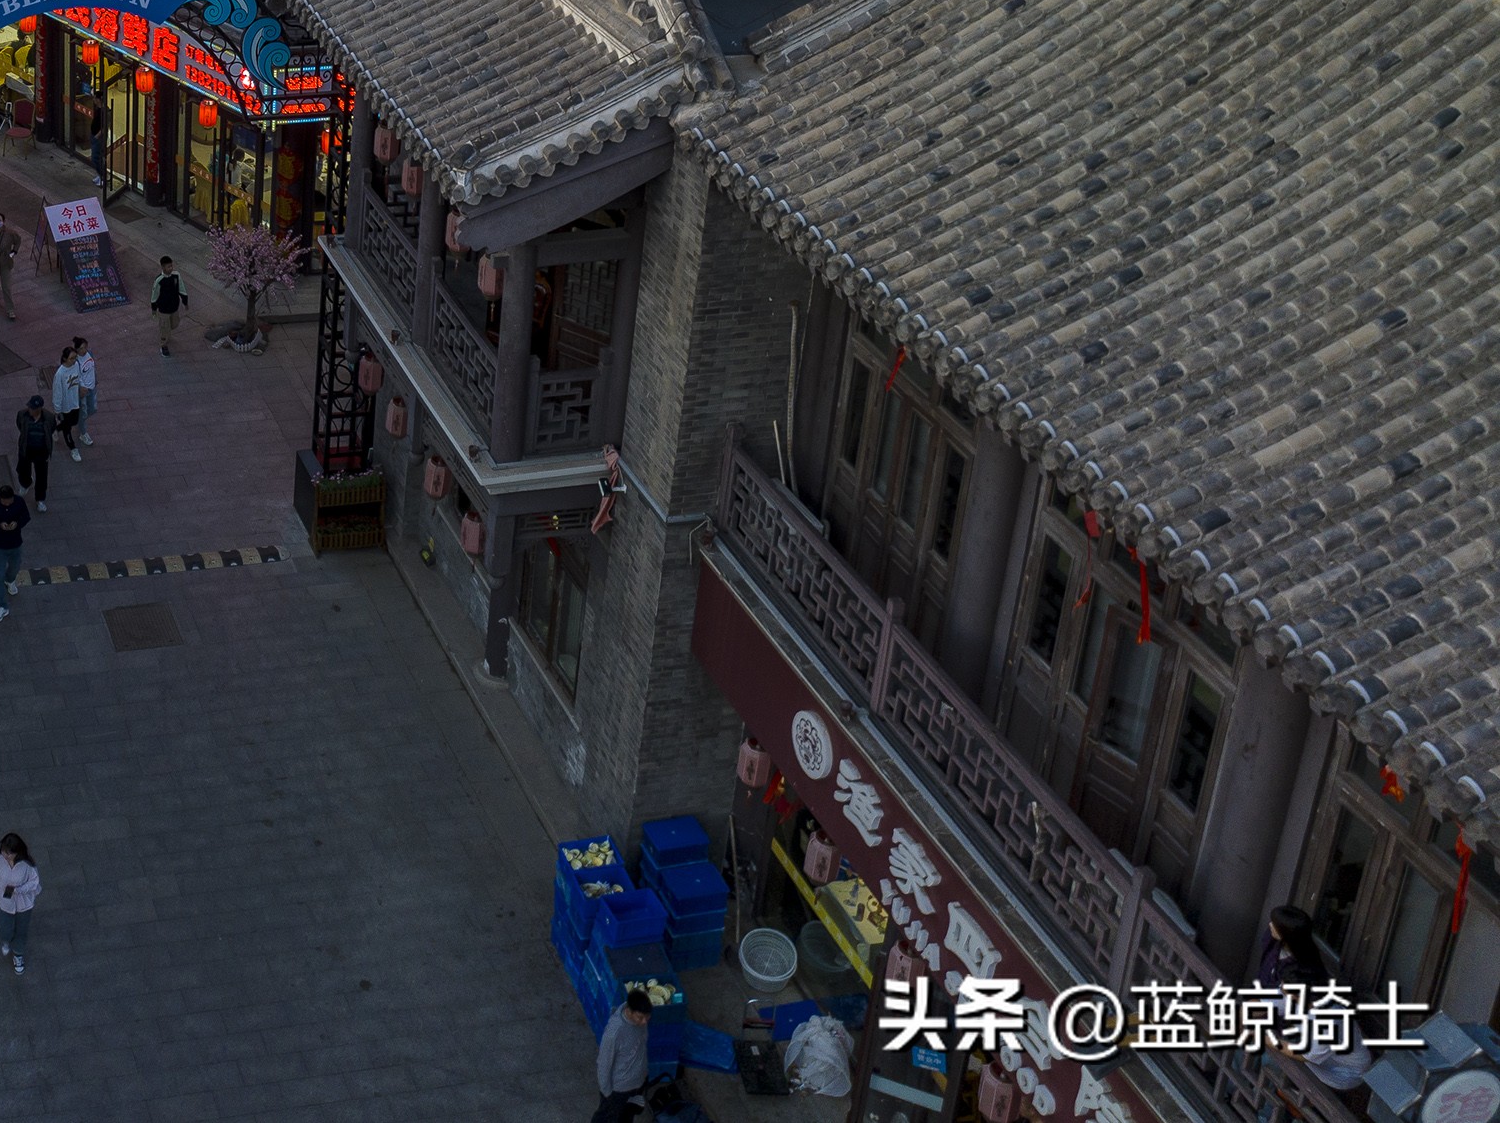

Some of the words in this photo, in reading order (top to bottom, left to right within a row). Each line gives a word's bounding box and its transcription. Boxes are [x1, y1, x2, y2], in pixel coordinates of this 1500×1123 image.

[61, 205, 88, 220] 今日
[58, 217, 100, 236] 特价菜
